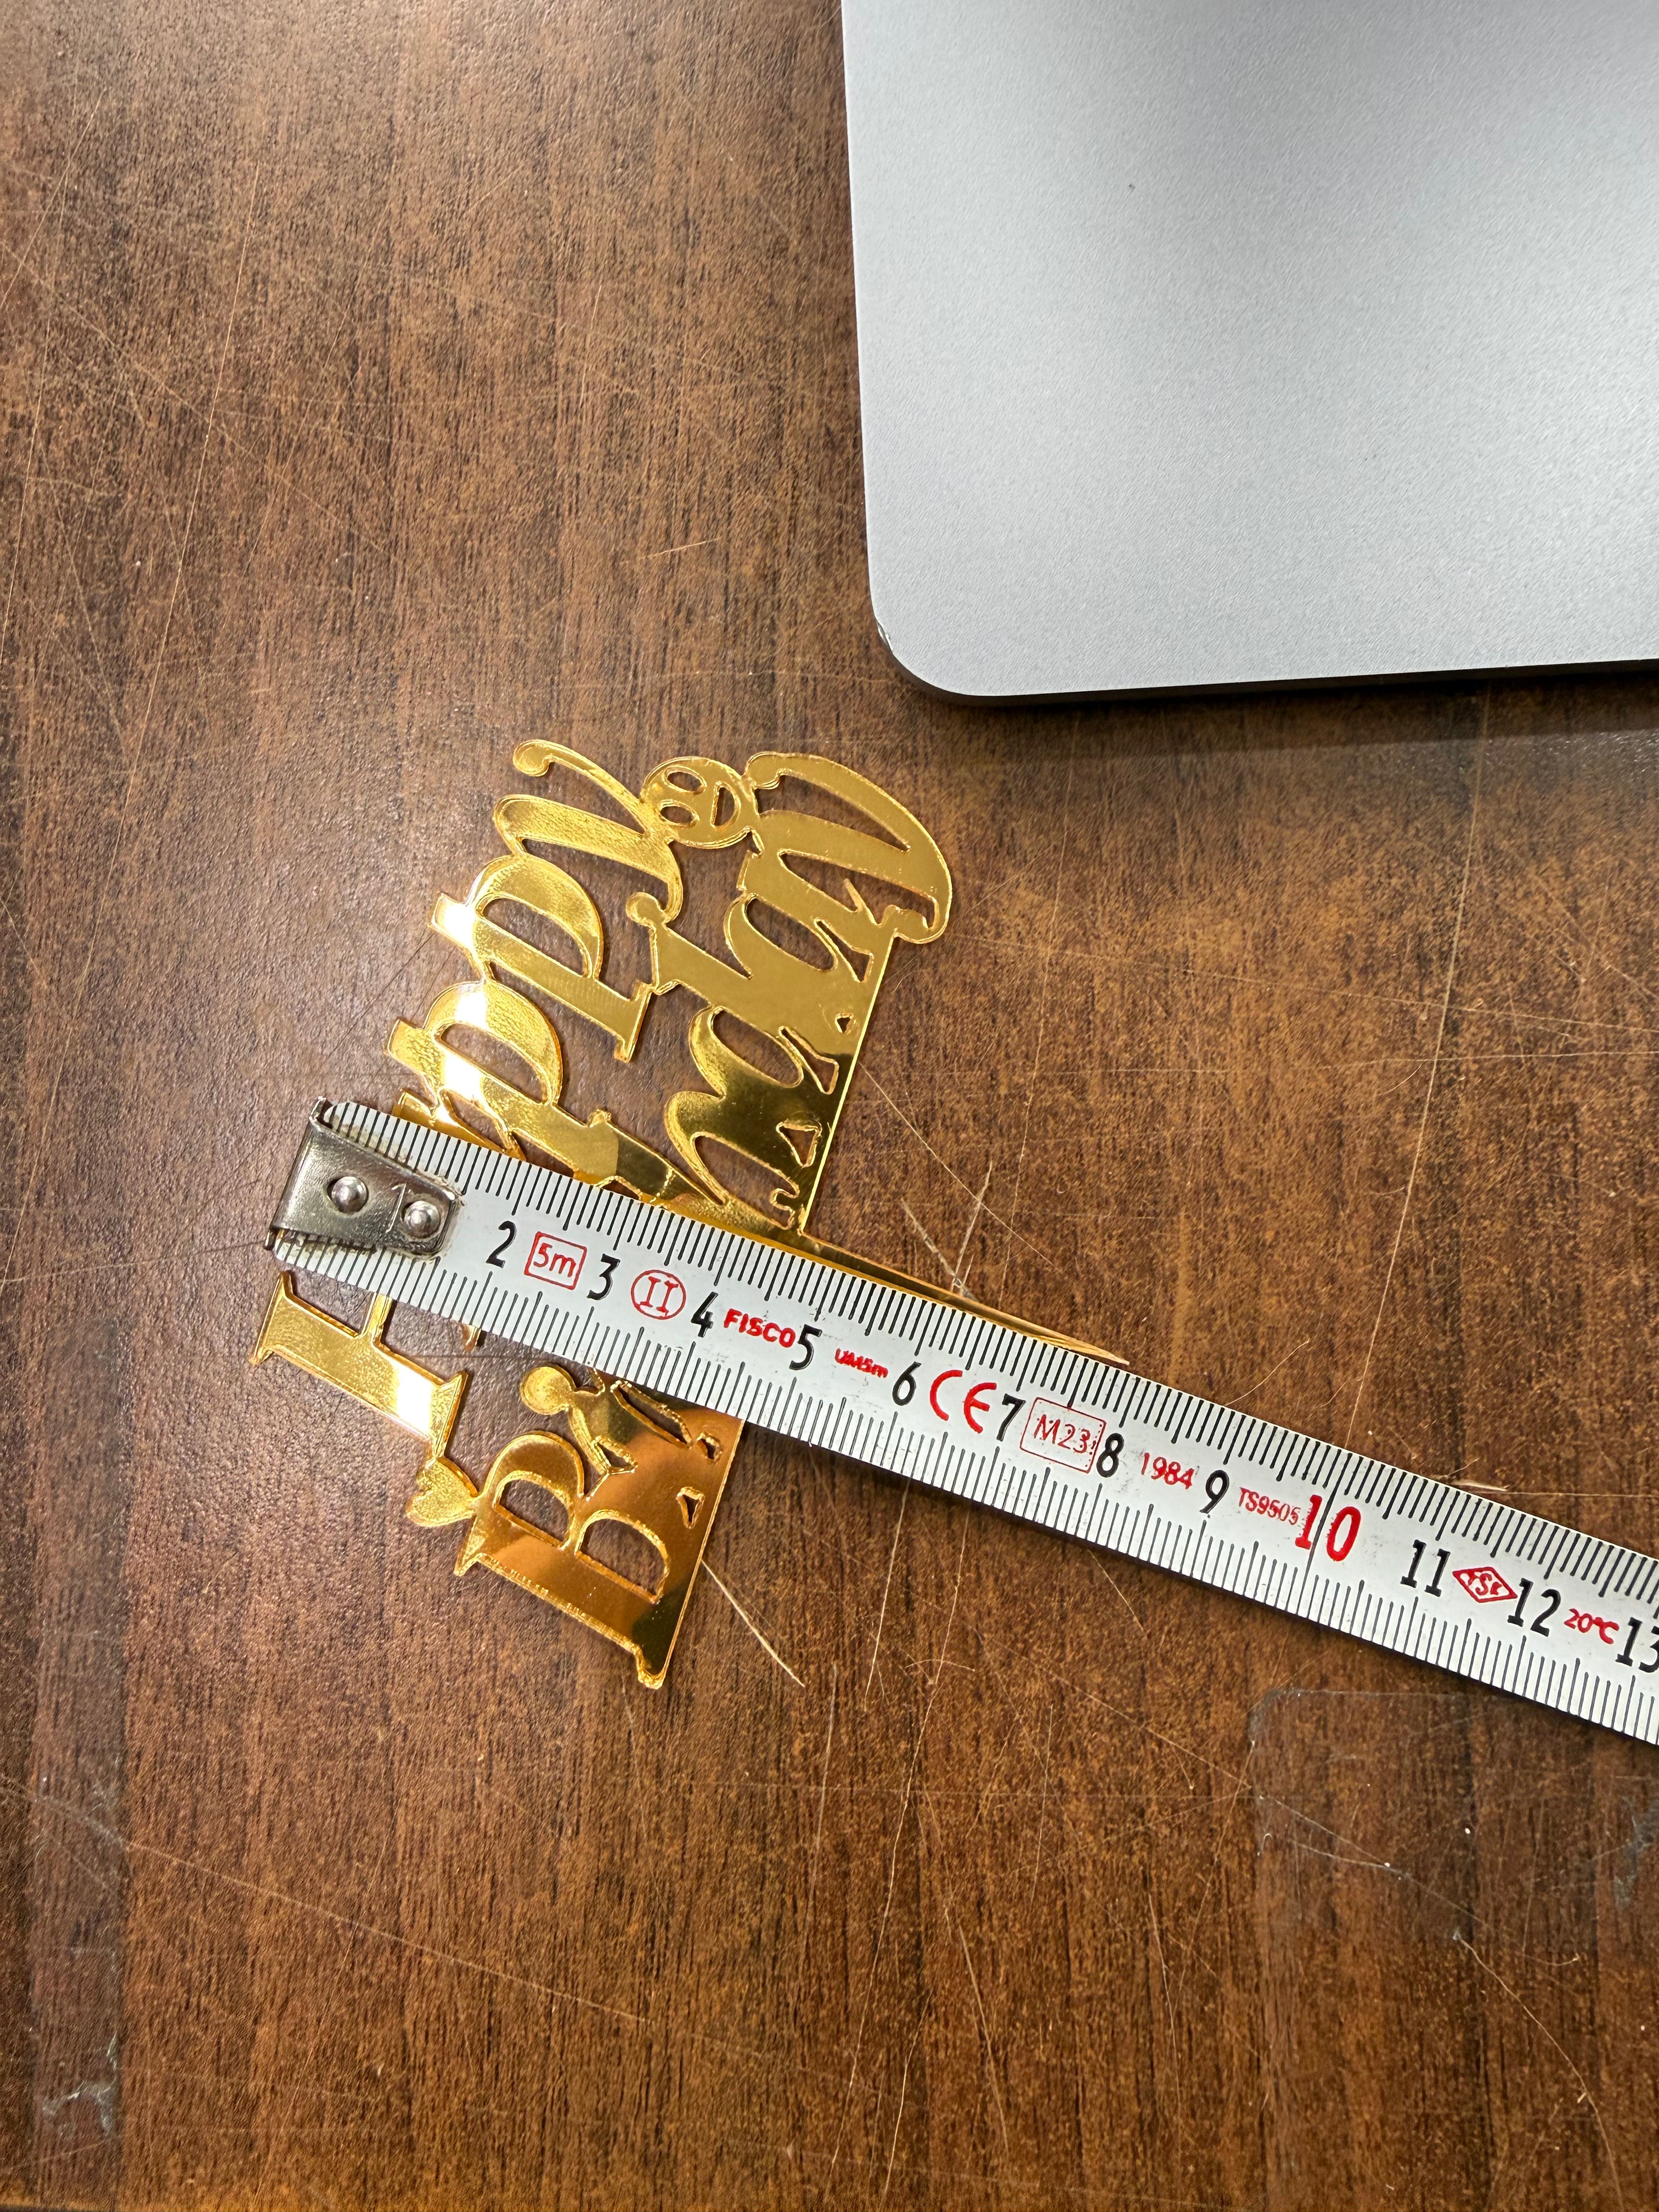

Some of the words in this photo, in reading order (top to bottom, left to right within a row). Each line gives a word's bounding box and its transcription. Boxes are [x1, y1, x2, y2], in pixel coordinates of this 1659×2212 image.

[486, 1221, 516, 1268] 2
[533, 1242, 577, 1277] 5m
[586, 1253, 620, 1300] 3
[640, 1276, 679, 1313] II
[690, 1291, 718, 1338] 4
[724, 1308, 795, 1348] FISCO
[789, 1324, 823, 1370] 5
[892, 1361, 922, 1406] 6
[929, 1369, 997, 1434] CE
[996, 1393, 1026, 1442] 7
[1034, 1414, 1091, 1454] M23
[1096, 1432, 1125, 1478] 8
[1141, 1452, 1195, 1490] 1984
[1201, 1470, 1230, 1515] 9
[1239, 1487, 1301, 1525] TS9505
[1295, 1494, 1362, 1562] 10
[1400, 1539, 1451, 1597] 11
[1507, 1578, 1561, 1637] 12
[1615, 1617, 1659, 1673] 13
